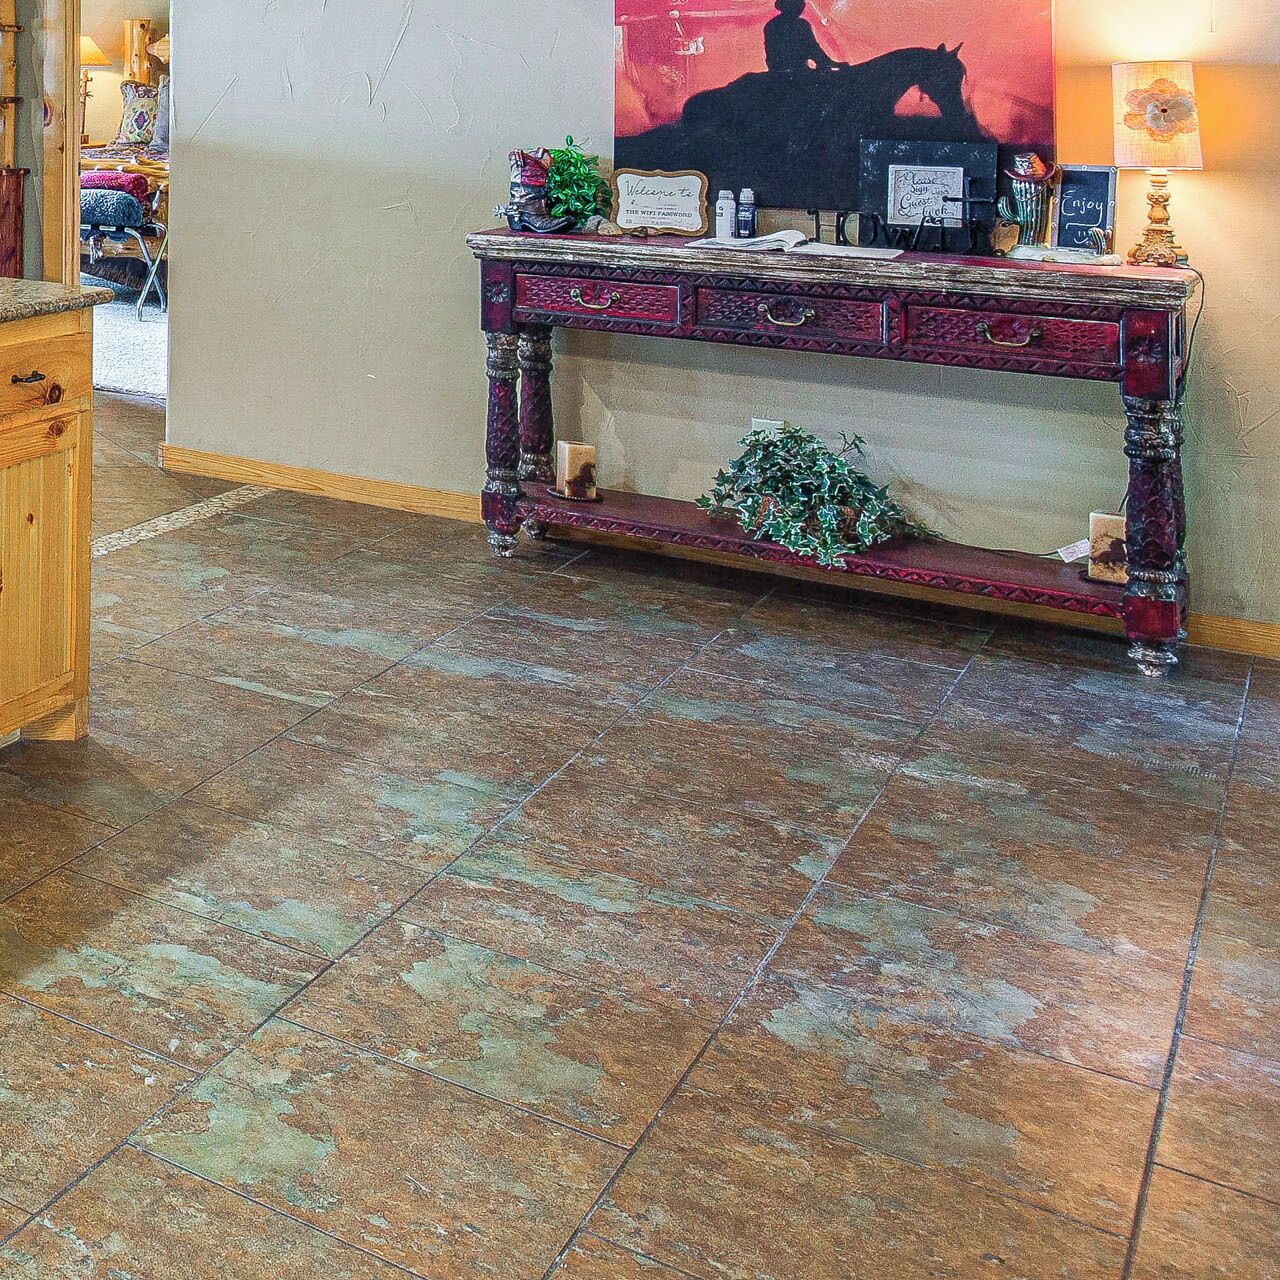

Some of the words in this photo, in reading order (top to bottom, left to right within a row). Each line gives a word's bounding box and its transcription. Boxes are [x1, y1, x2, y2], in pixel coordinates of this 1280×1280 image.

[625, 178, 677, 200] Welcome
[678, 187, 695, 198] to
[1061, 189, 1103, 228] Enjoy
